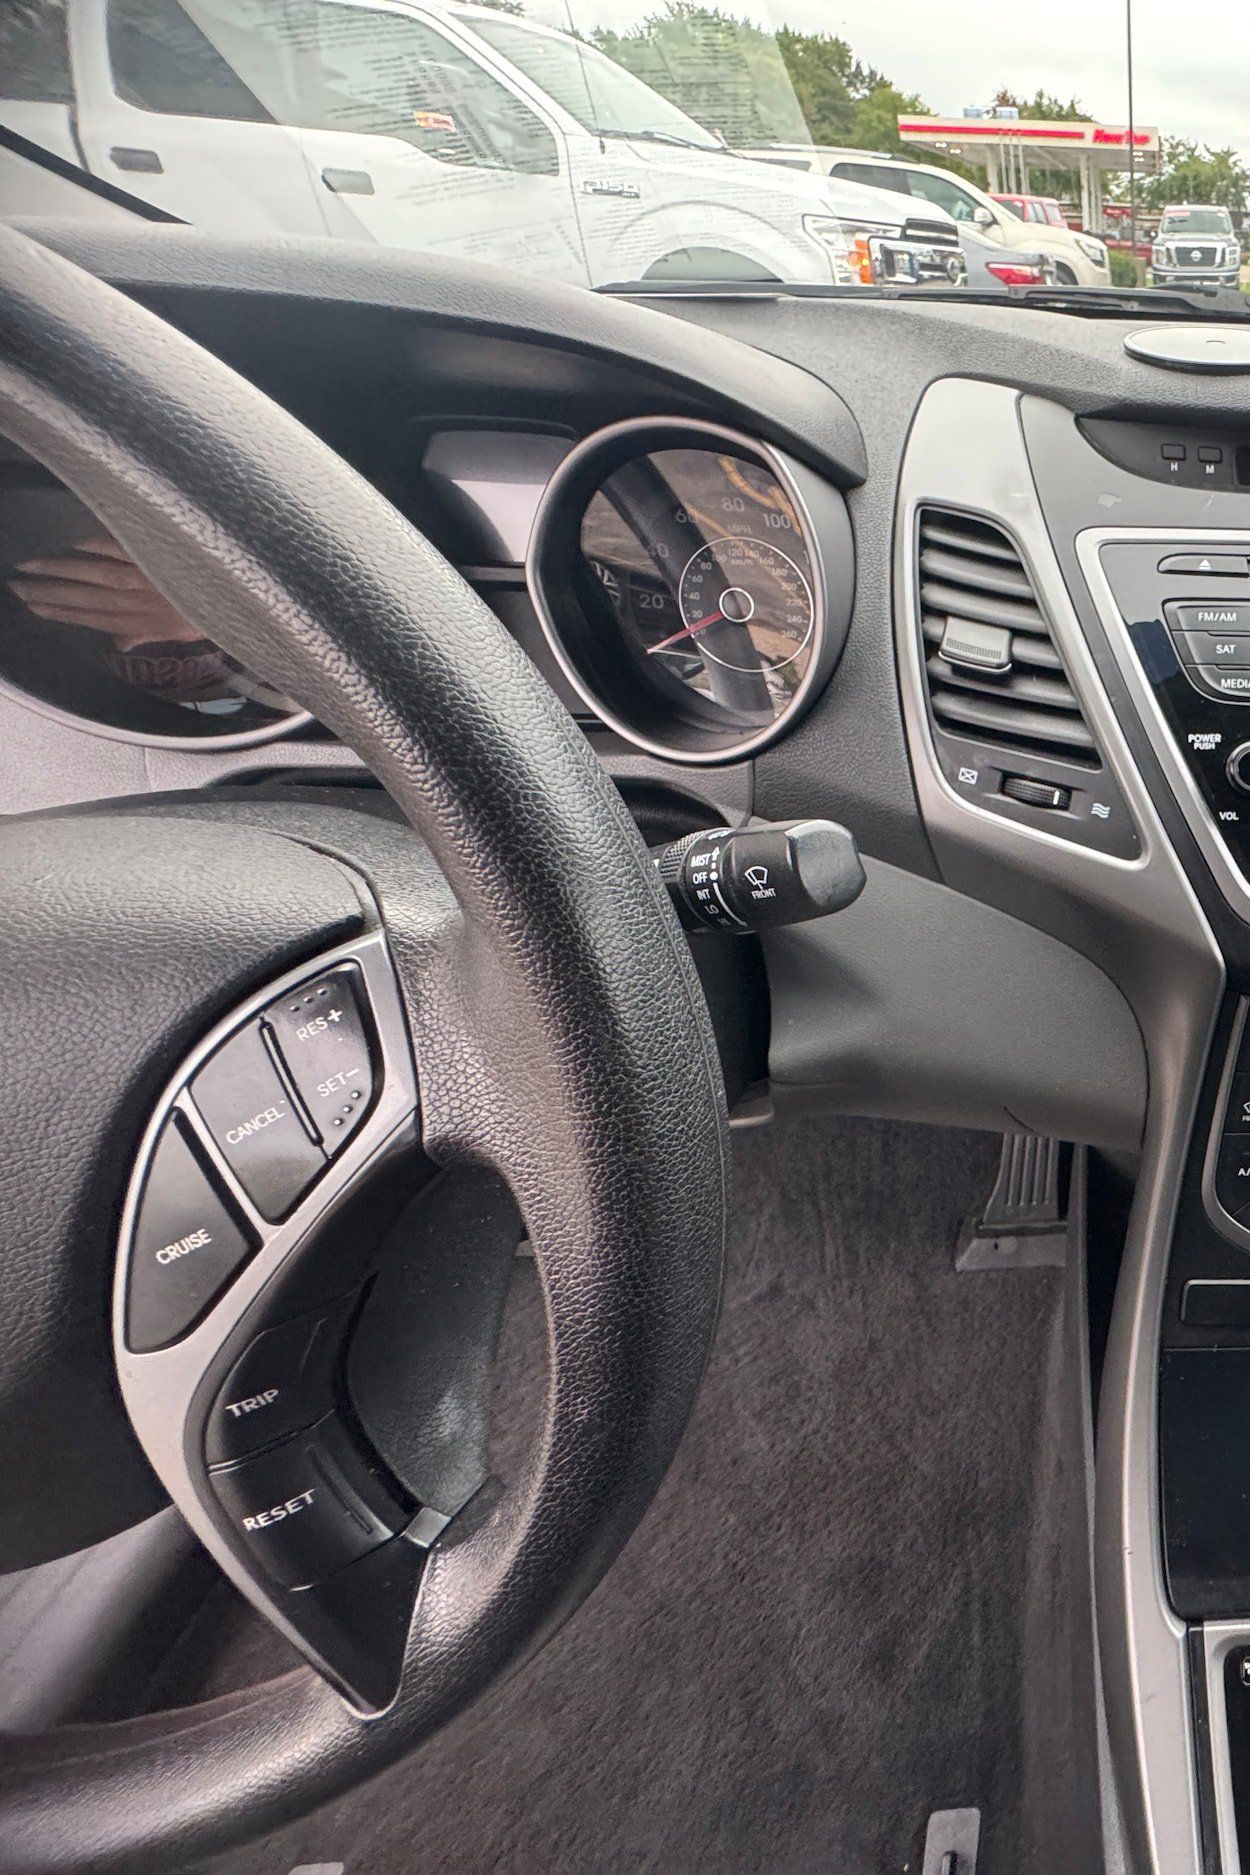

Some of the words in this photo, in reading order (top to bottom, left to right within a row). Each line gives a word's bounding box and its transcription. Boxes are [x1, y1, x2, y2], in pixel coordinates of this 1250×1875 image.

[1170, 463, 1178, 472] H
[1206, 465, 1214, 474] M
[723, 497, 744, 512] 80
[763, 512, 791, 529] 100
[700, 562, 712, 570] 80
[640, 594, 664, 609] 20
[689, 592, 700, 600] 40
[692, 610, 703, 618] 20
[1198, 612, 1237, 622] FM/AM
[1216, 645, 1236, 655] SAT
[1188, 733, 1222, 744] POWER
[1194, 742, 1215, 750] PUSH
[1219, 811, 1239, 821] VOL
[691, 853, 711, 867] MIST
[693, 871, 707, 885] OFF
[696, 888, 711, 901] INT
[751, 888, 776, 900] FRONT
[226, 1106, 285, 1144] CANCEL
[155, 1228, 212, 1265] CRUISE
[225, 1389, 279, 1417] TRIP
[243, 1489, 315, 1531] RESET
